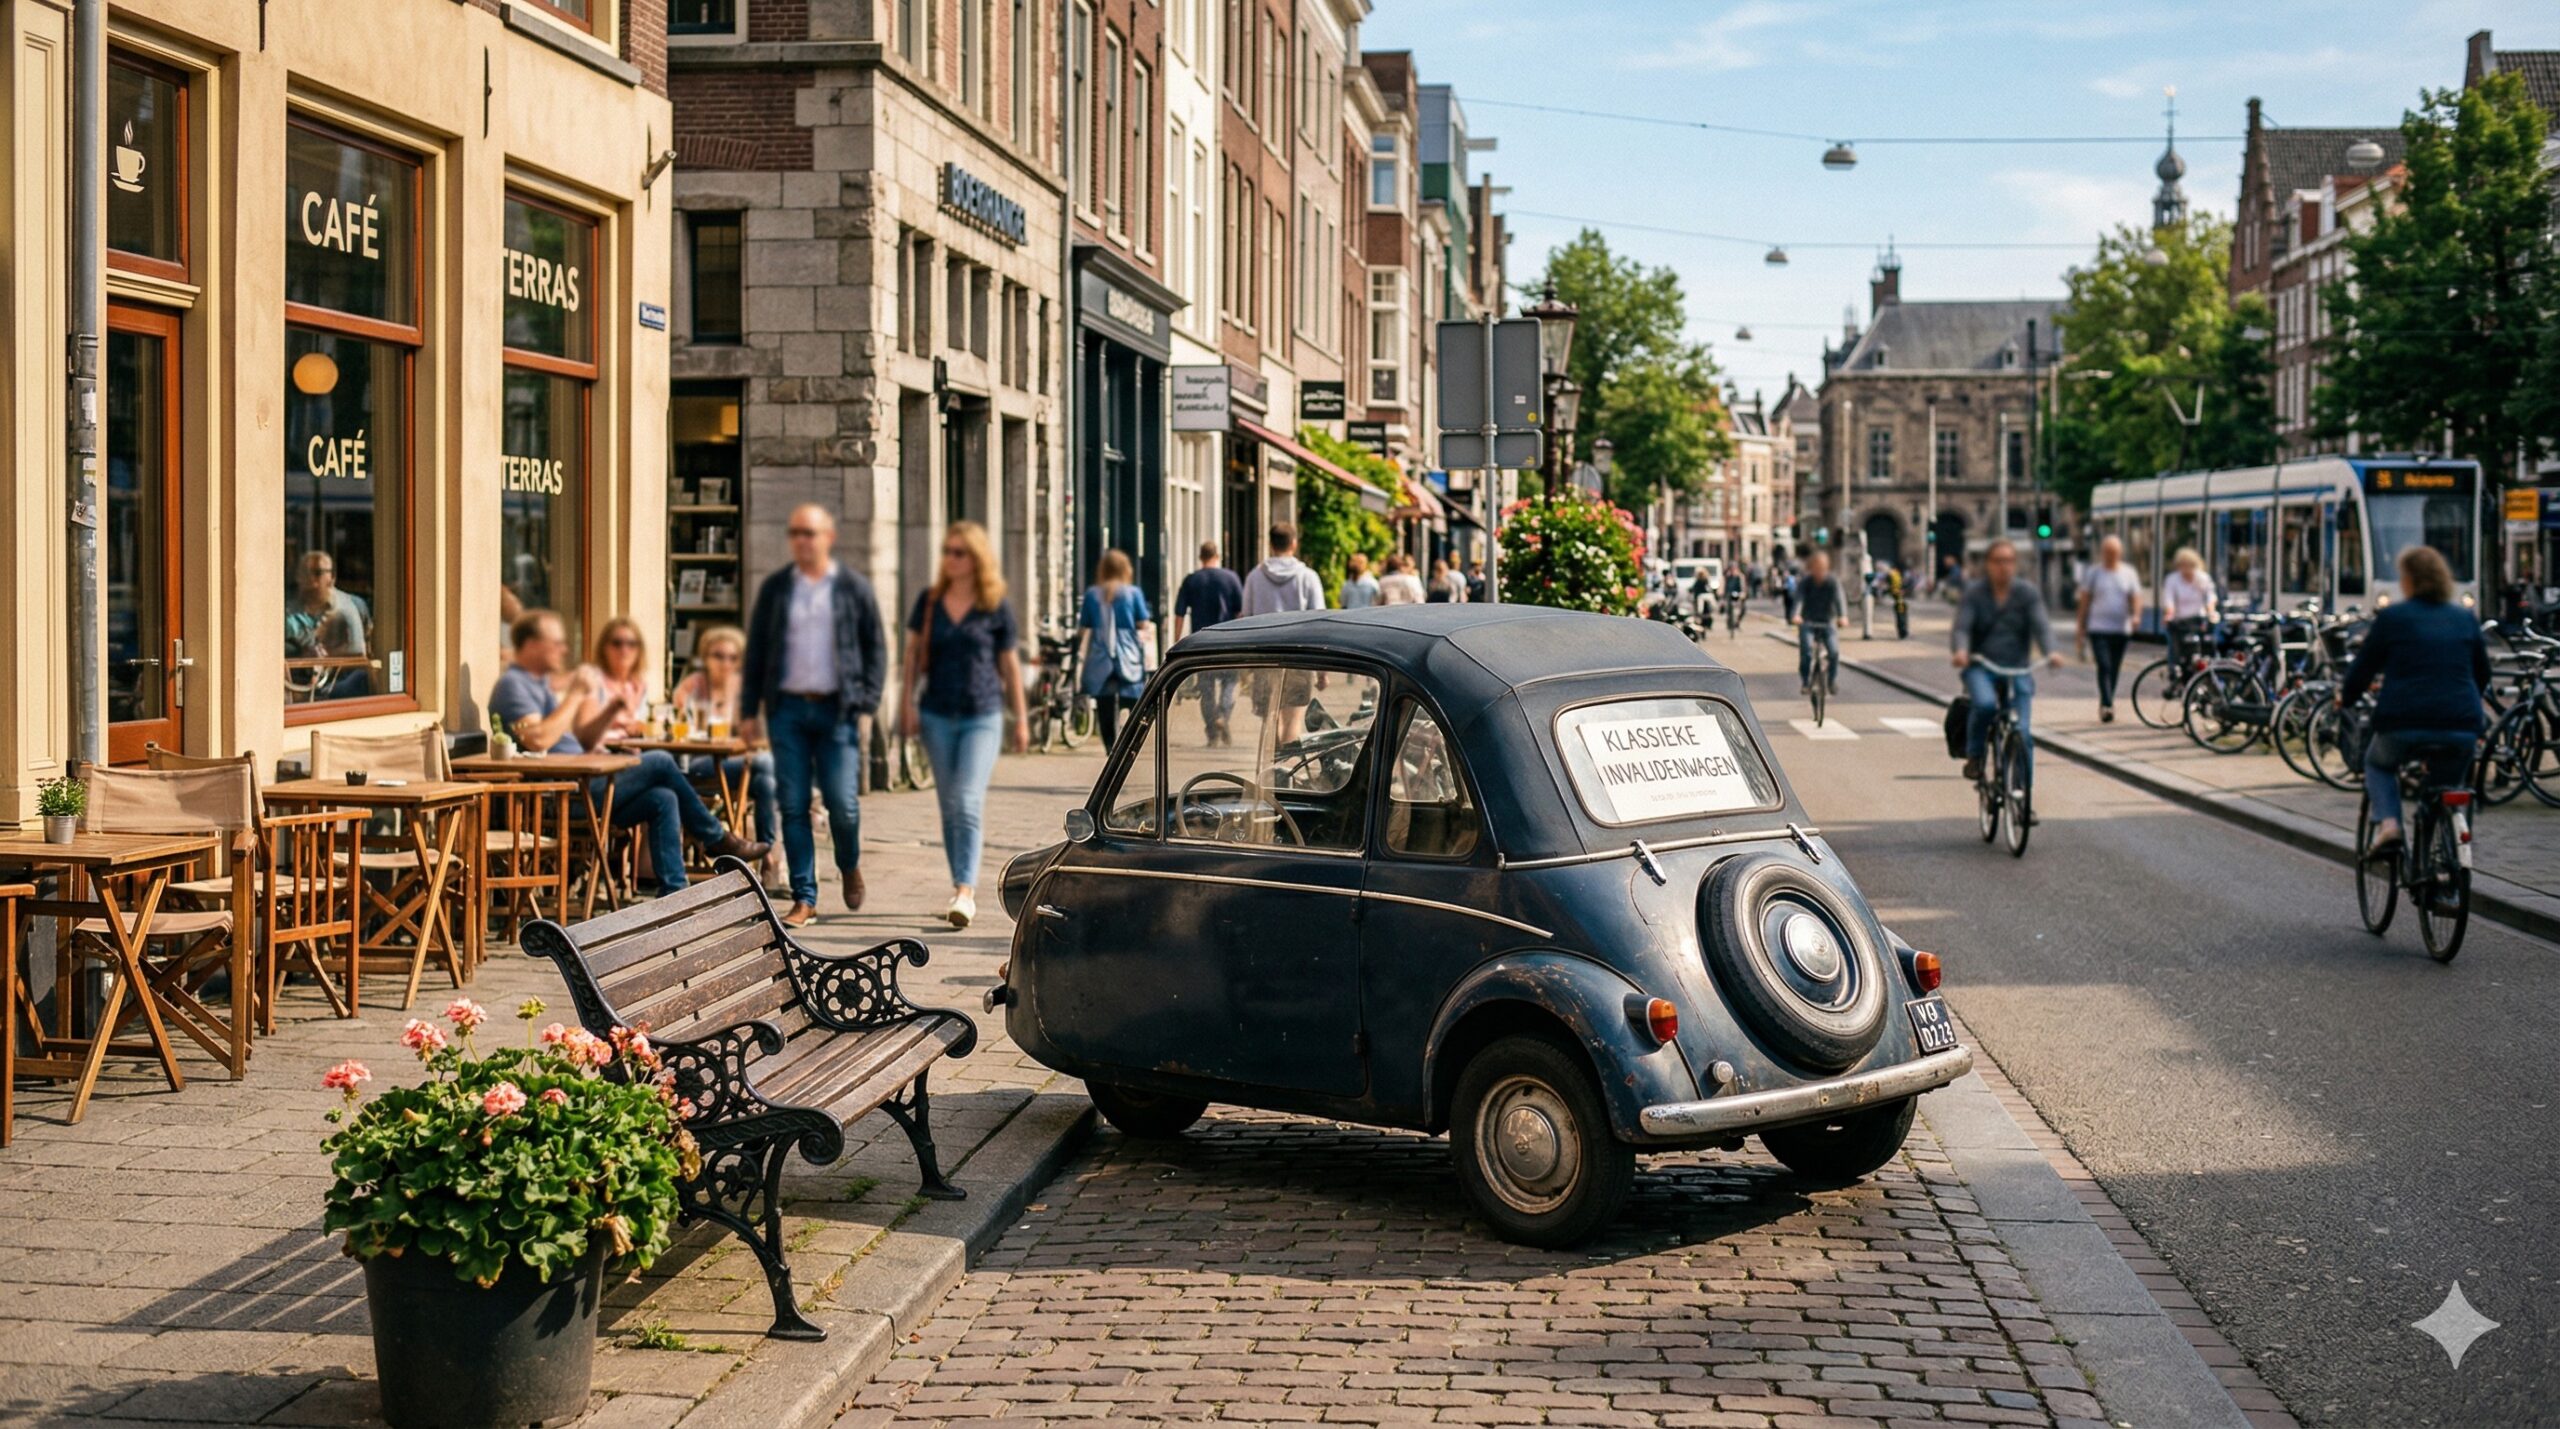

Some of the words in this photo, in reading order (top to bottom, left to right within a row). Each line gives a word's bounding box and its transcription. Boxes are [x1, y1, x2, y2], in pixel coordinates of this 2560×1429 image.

[302, 191, 379, 260] CAFÉ
[308, 429, 366, 479] CAFÉ
[500, 455, 563, 495] TERRAS
[1601, 725, 1701, 753] KLASSIEKE
[1602, 755, 1739, 787] INVALIDENWAGEN
